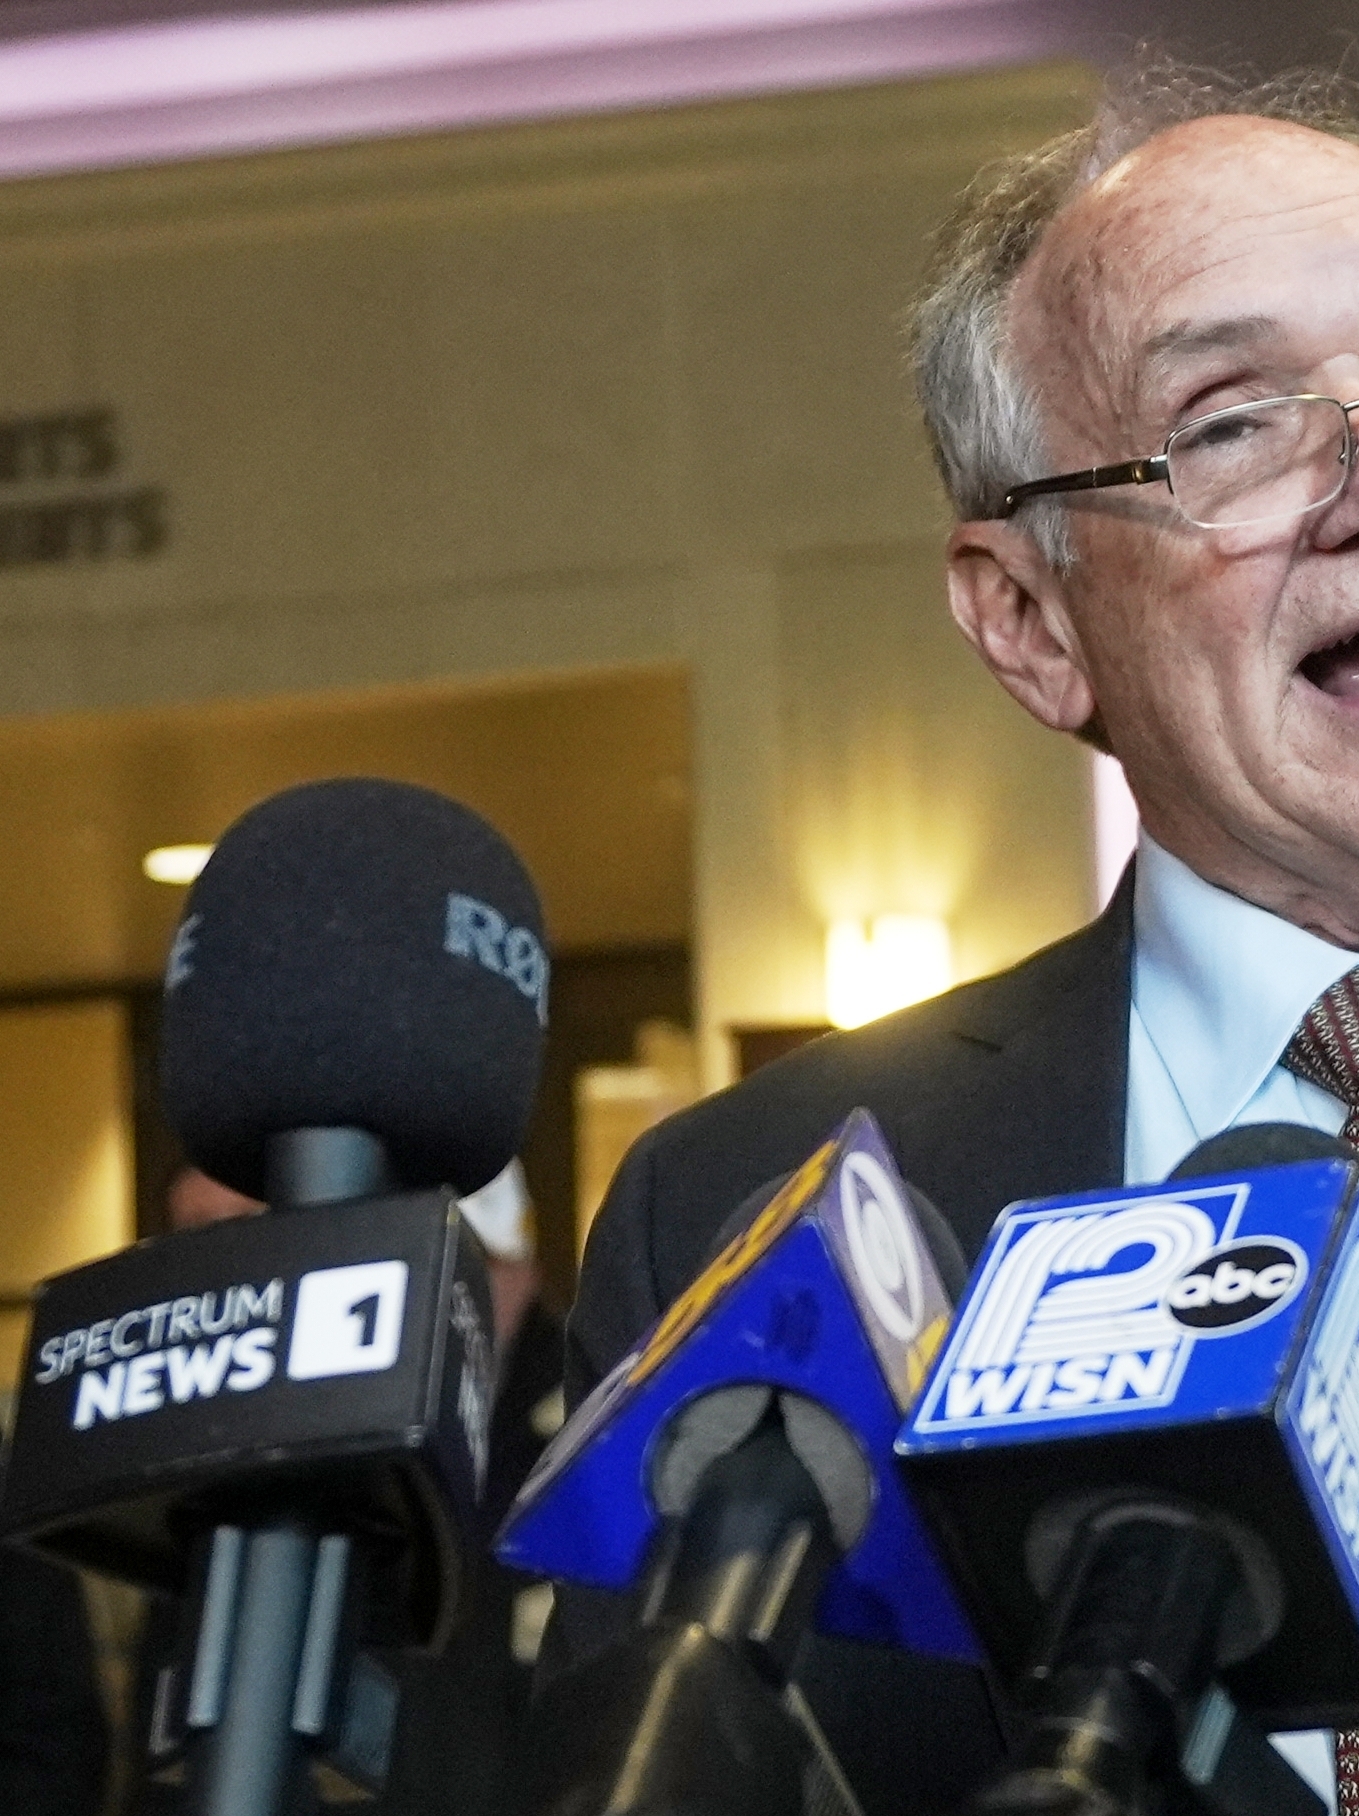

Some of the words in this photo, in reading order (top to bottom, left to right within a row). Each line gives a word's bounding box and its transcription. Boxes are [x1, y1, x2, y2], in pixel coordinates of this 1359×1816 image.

[1166, 1261, 1296, 1310] abc
[35, 1277, 285, 1384] SPECTRUM
[72, 1326, 277, 1430] NEWS
[943, 1350, 1174, 1419] WISN
